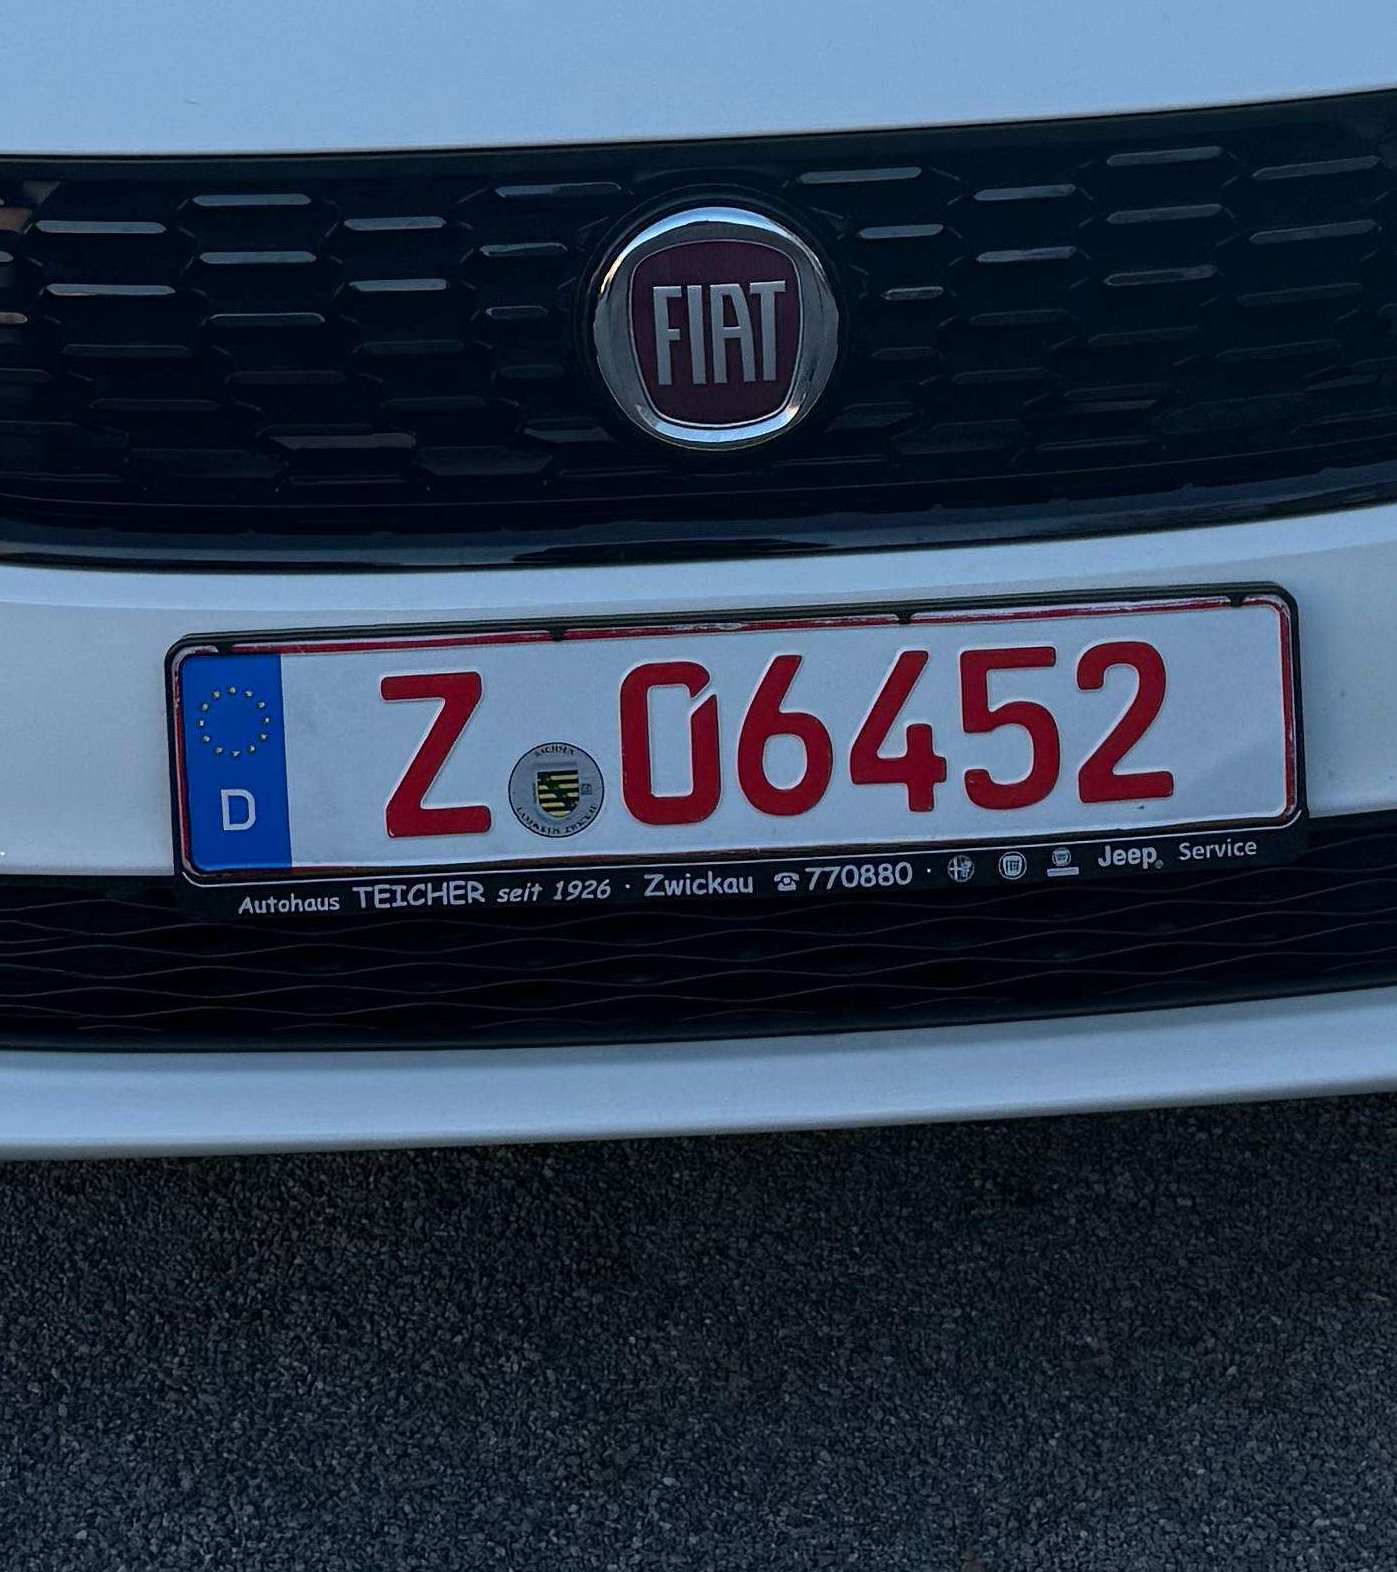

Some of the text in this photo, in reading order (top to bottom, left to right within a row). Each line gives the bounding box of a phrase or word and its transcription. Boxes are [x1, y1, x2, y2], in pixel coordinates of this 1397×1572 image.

[653, 280, 786, 385] FIAT
[379, 640, 1176, 839] Z 06452
[220, 789, 256, 831] D
[238, 892, 340, 915] Autohaus
[352, 881, 485, 909] TEICHER
[497, 882, 542, 904] seit
[553, 878, 611, 902] 1926
[644, 871, 753, 897] Zwickau
[804, 861, 913, 891] 770880
[1178, 838, 1257, 861] Service
